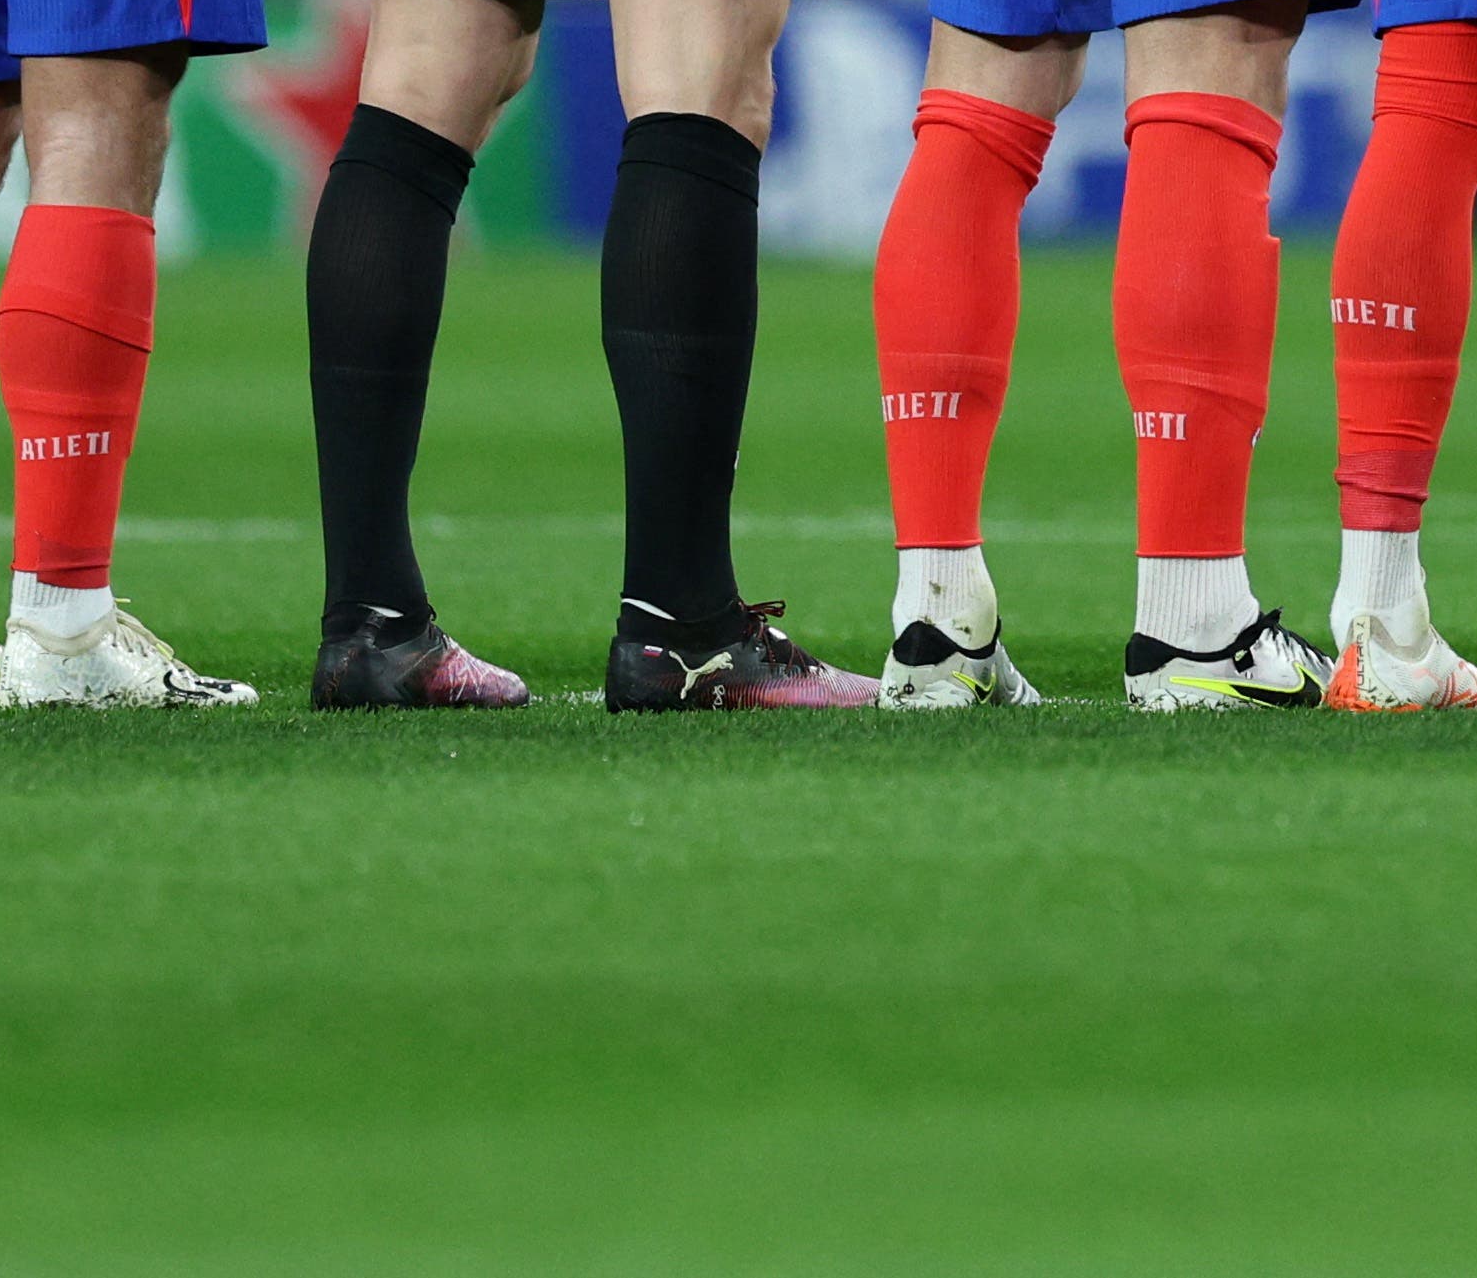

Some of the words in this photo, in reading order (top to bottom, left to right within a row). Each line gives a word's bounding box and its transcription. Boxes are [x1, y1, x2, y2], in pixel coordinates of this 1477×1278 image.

[1331, 297, 1417, 332] TLETI
[881, 392, 962, 422] TLETI
[20, 430, 112, 462] ATLETI
